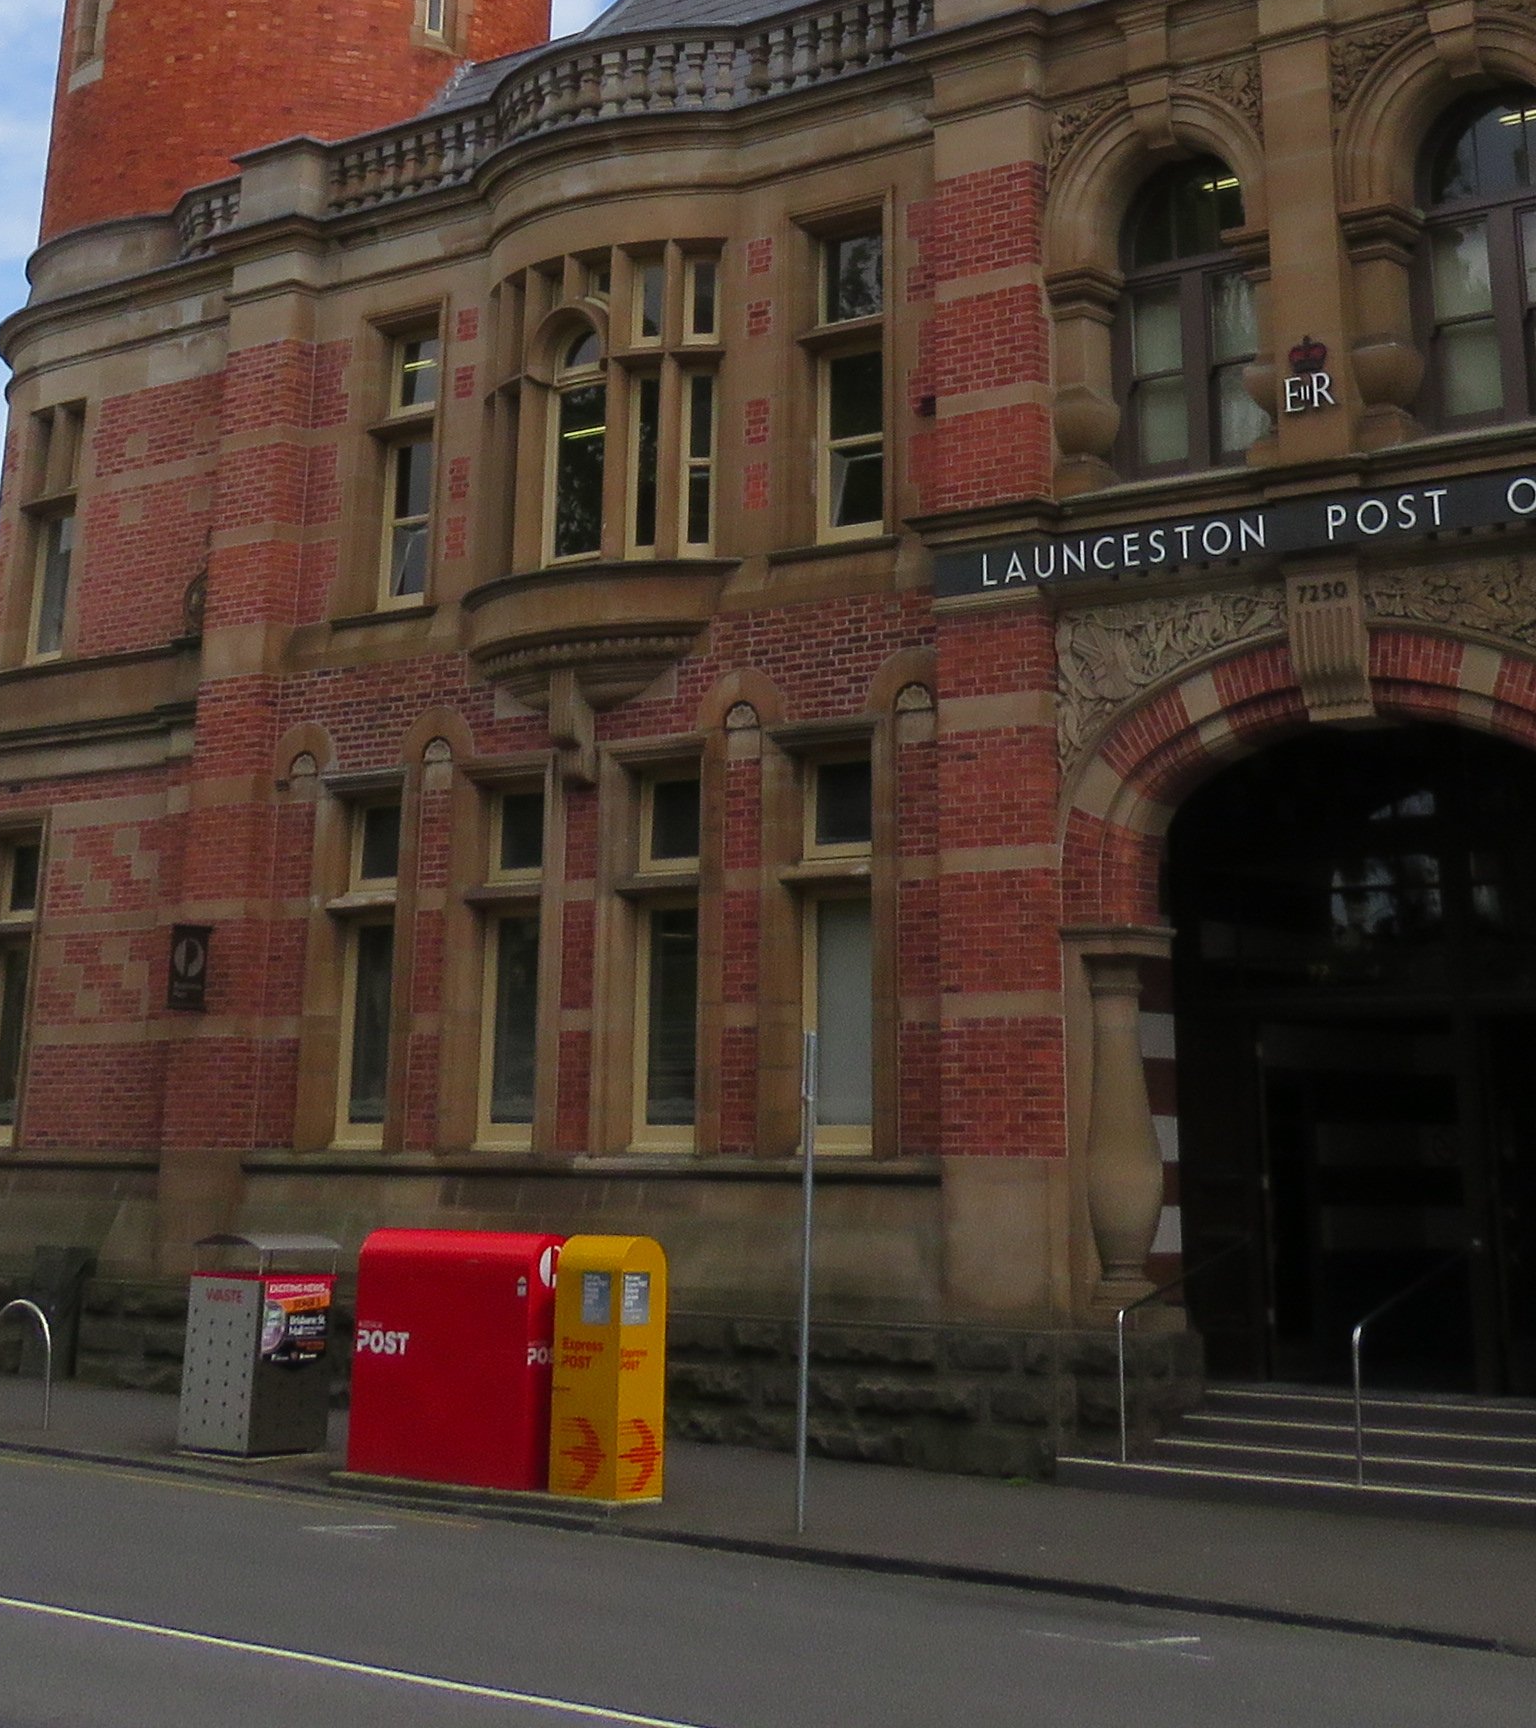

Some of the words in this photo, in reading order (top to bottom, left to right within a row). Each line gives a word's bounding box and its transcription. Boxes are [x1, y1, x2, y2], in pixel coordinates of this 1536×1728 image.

[982, 514, 1266, 587] LAUNCESTON
[1326, 489, 1448, 540] POST
[205, 1288, 244, 1306] WASTE
[357, 1329, 410, 1356] POST
[562, 1337, 604, 1353] Express
